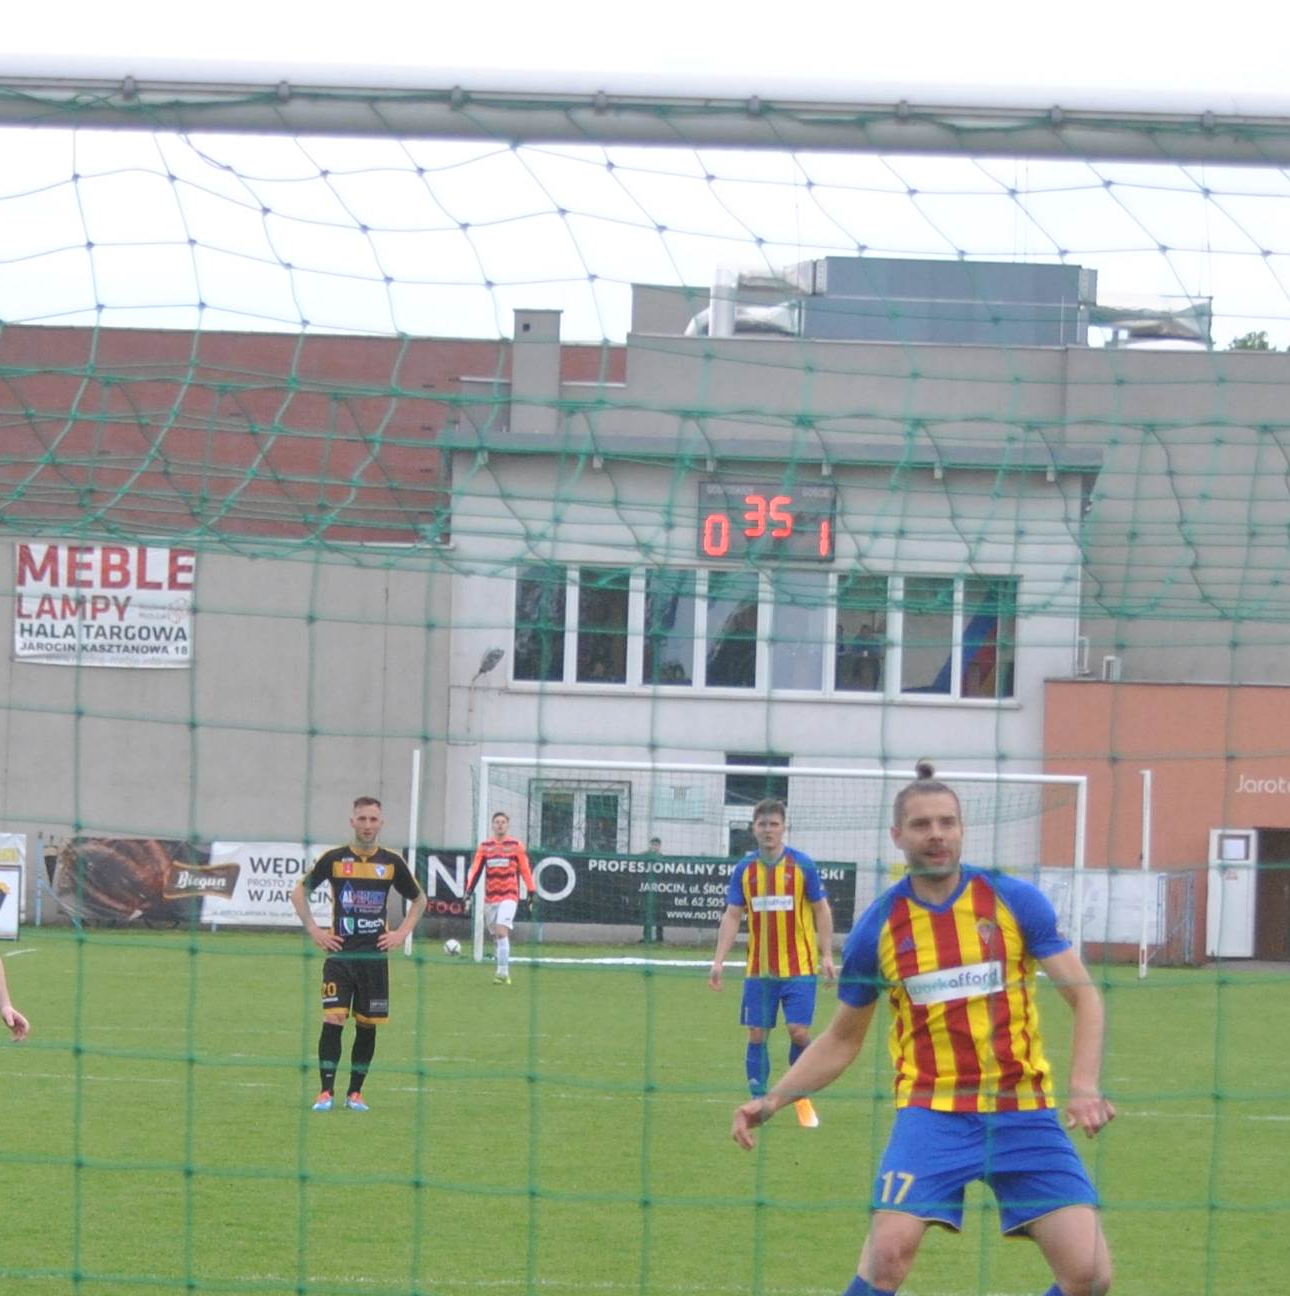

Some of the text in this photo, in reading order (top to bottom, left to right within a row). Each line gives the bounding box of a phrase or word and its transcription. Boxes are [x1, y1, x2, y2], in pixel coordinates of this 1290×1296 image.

[743, 494, 794, 538] 35
[703, 513, 730, 557] 0
[819, 519, 831, 557] 1
[17, 544, 196, 591] MEBLE
[17, 593, 132, 622] LAMPY
[20, 623, 187, 642] HALA TARGOWA
[20, 642, 188, 655] JAROCIN KASZTANOWA 18
[588, 860, 713, 876] PROFESJONALNY
[247, 879, 285, 888] PROSTO
[248, 890, 264, 901] W
[881, 1170, 914, 1204] 17
